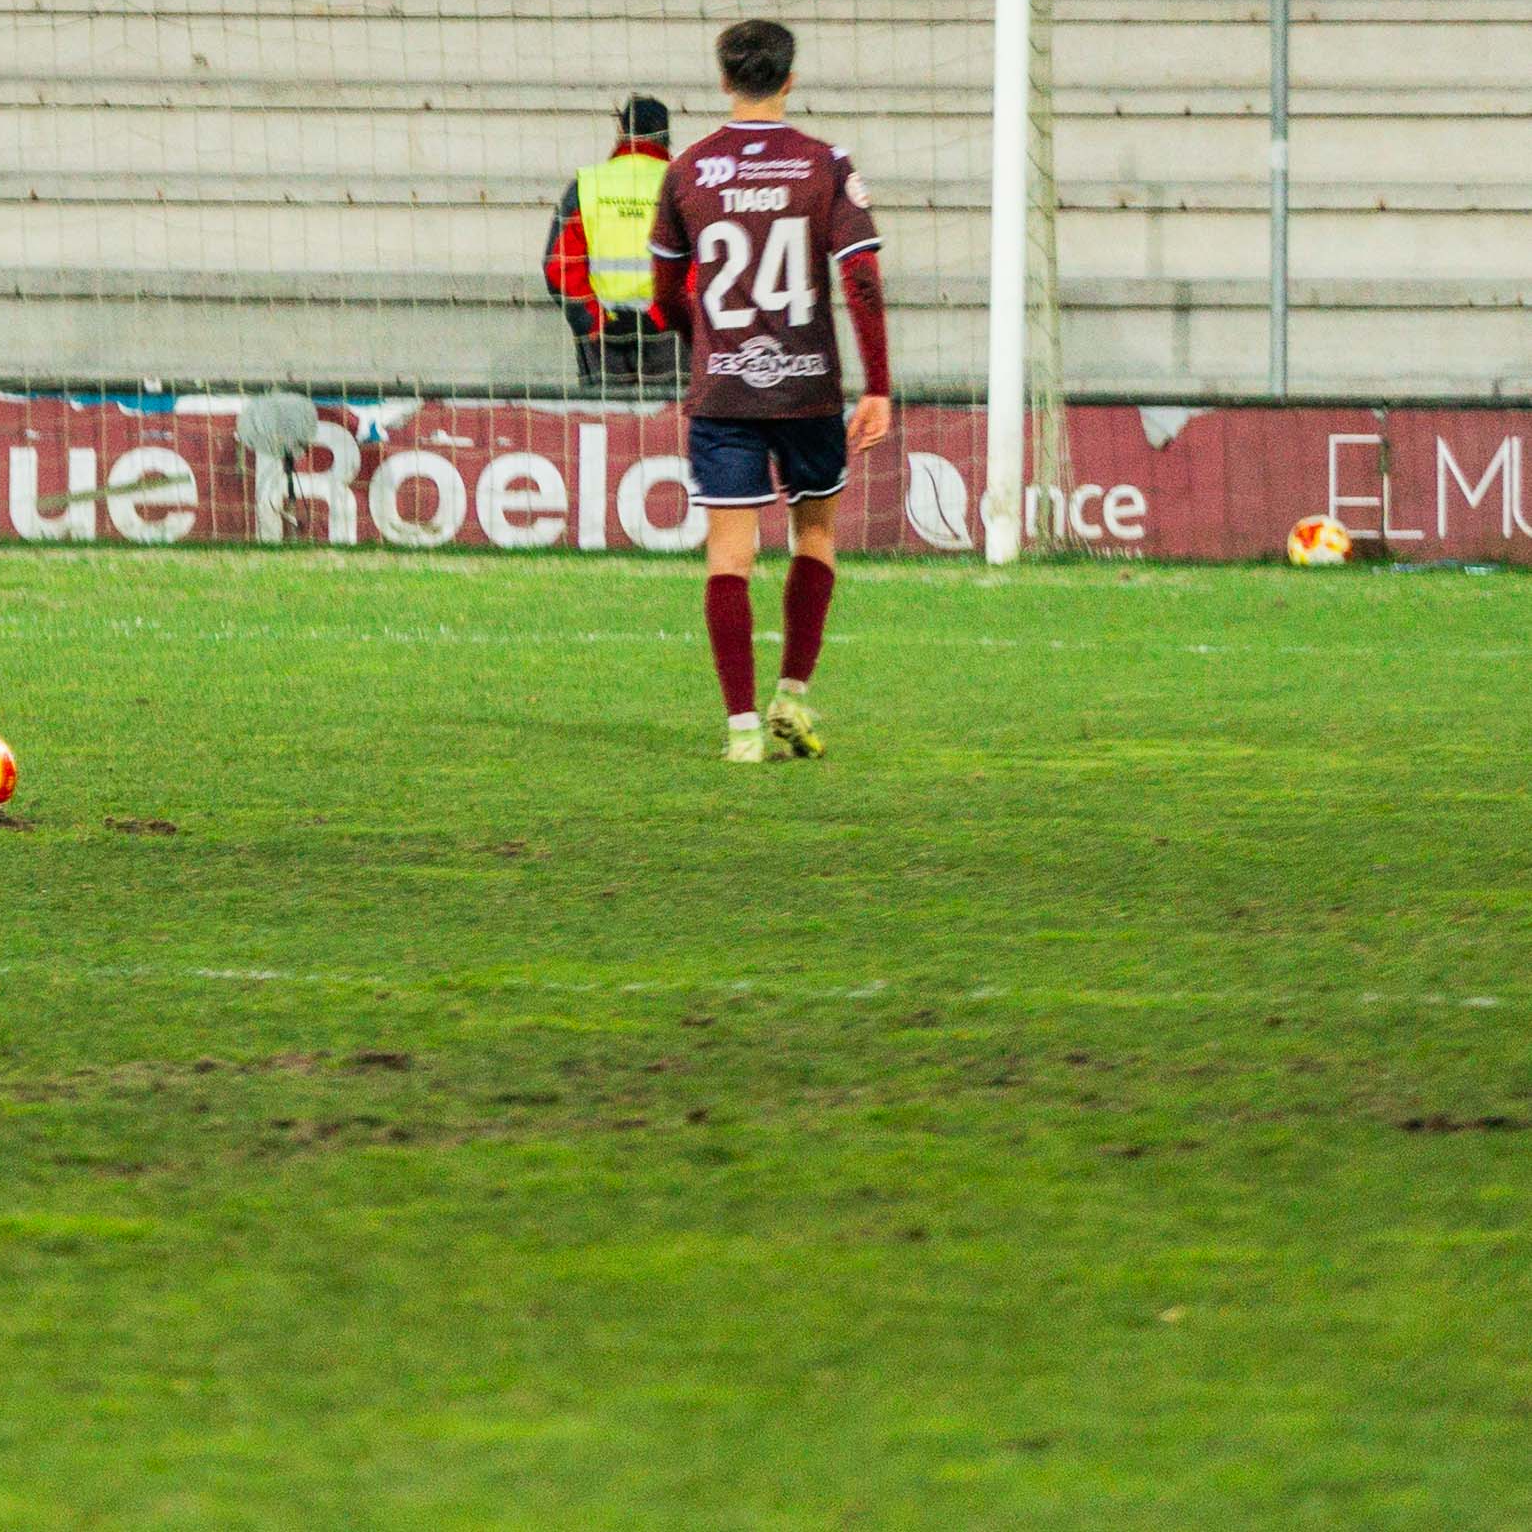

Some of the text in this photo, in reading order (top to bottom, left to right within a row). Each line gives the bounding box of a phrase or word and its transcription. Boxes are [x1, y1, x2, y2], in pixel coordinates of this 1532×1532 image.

[719, 186, 792, 214] TIAGO
[697, 216, 819, 332] 24
[254, 418, 710, 552] Roelo
